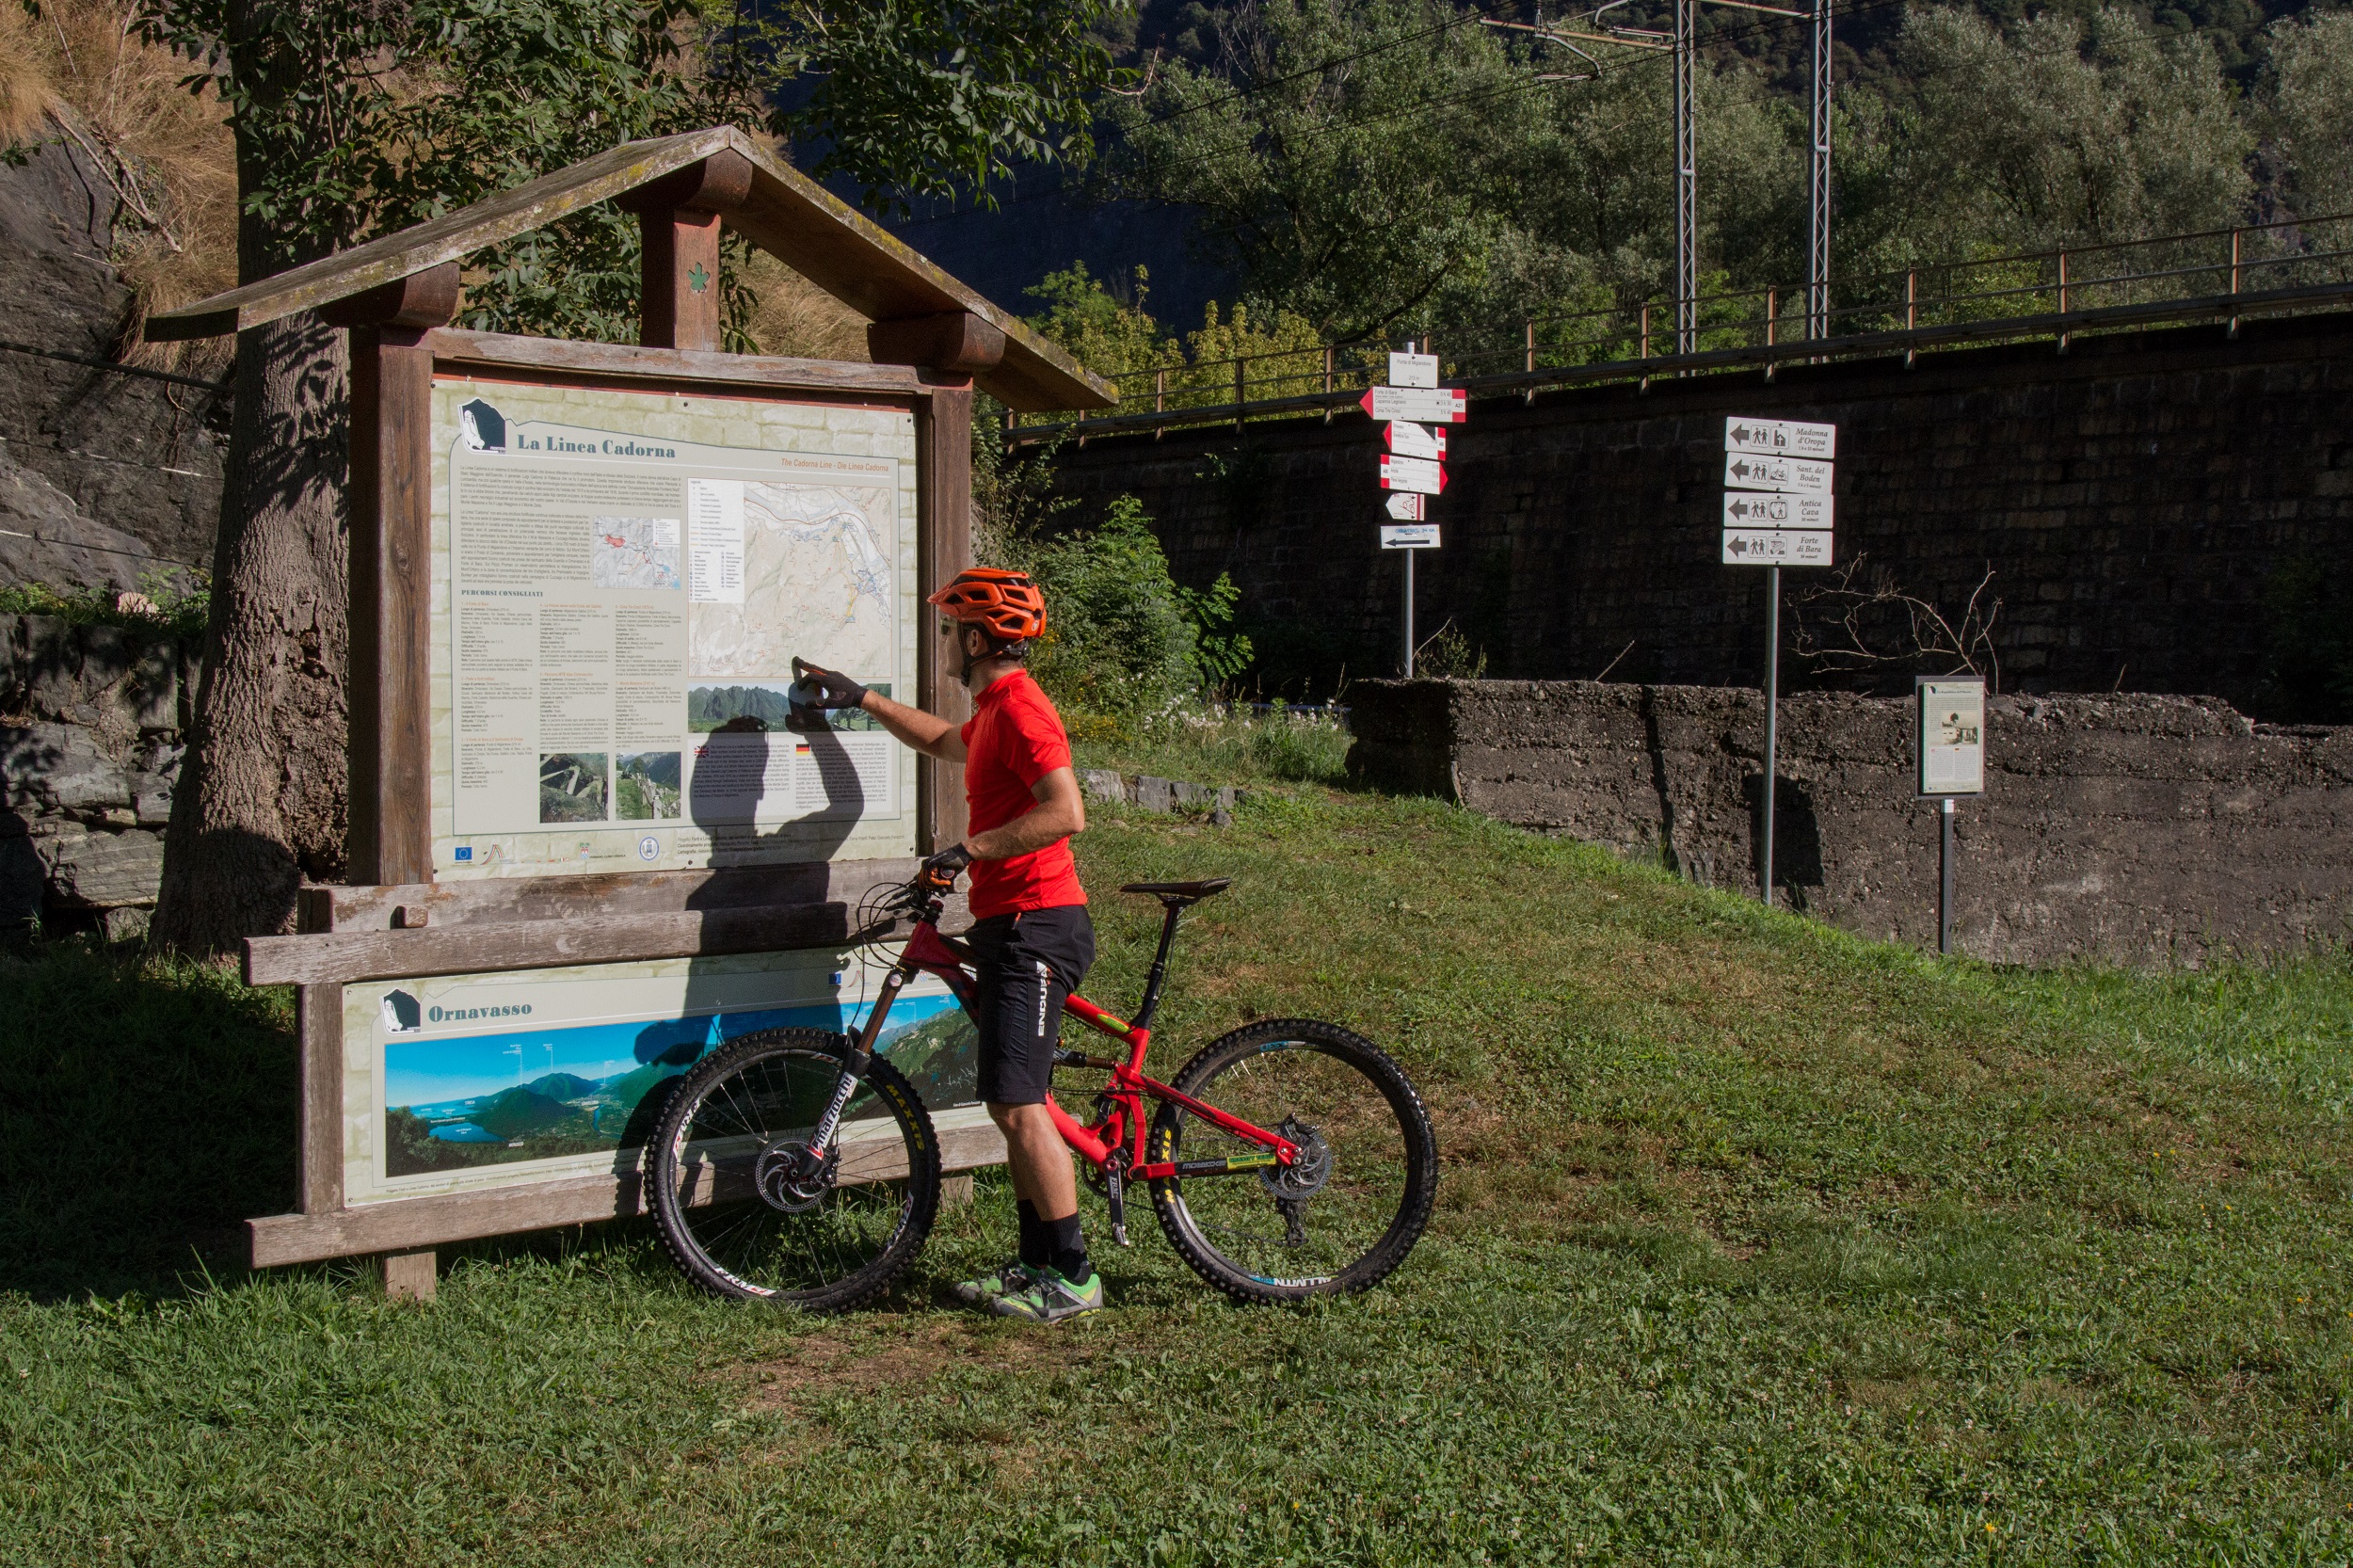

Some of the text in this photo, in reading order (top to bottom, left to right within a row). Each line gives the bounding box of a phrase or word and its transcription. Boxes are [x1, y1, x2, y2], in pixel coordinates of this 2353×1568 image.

[1796, 428, 1828, 437] Madonna
[1798, 437, 1826, 446] d'Oropa
[518, 434, 675, 458] La Linea Cadorna
[793, 459, 818, 468] Cadorna
[866, 463, 888, 472] Cadorna
[429, 1003, 532, 1022] Ornavasso
[816, 1074, 853, 1144] marzocchi
[887, 1084, 924, 1150] MAXXIS
